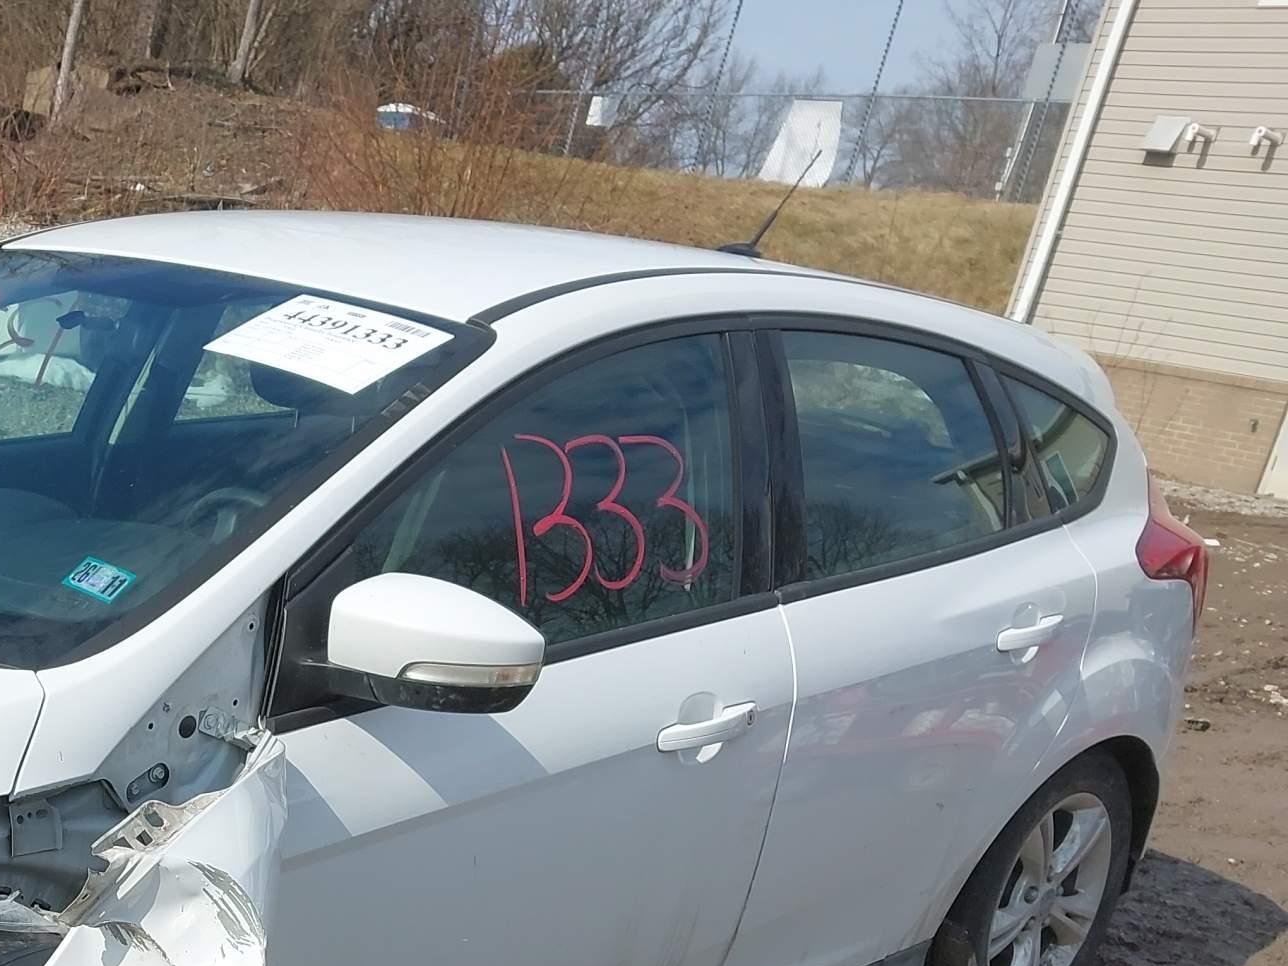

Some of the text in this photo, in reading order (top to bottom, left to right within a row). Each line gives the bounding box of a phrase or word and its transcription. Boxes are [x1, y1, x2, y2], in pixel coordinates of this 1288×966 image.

[283, 311, 408, 349] 44391333
[501, 434, 709, 607] 1333
[71, 562, 128, 597] 26 11
